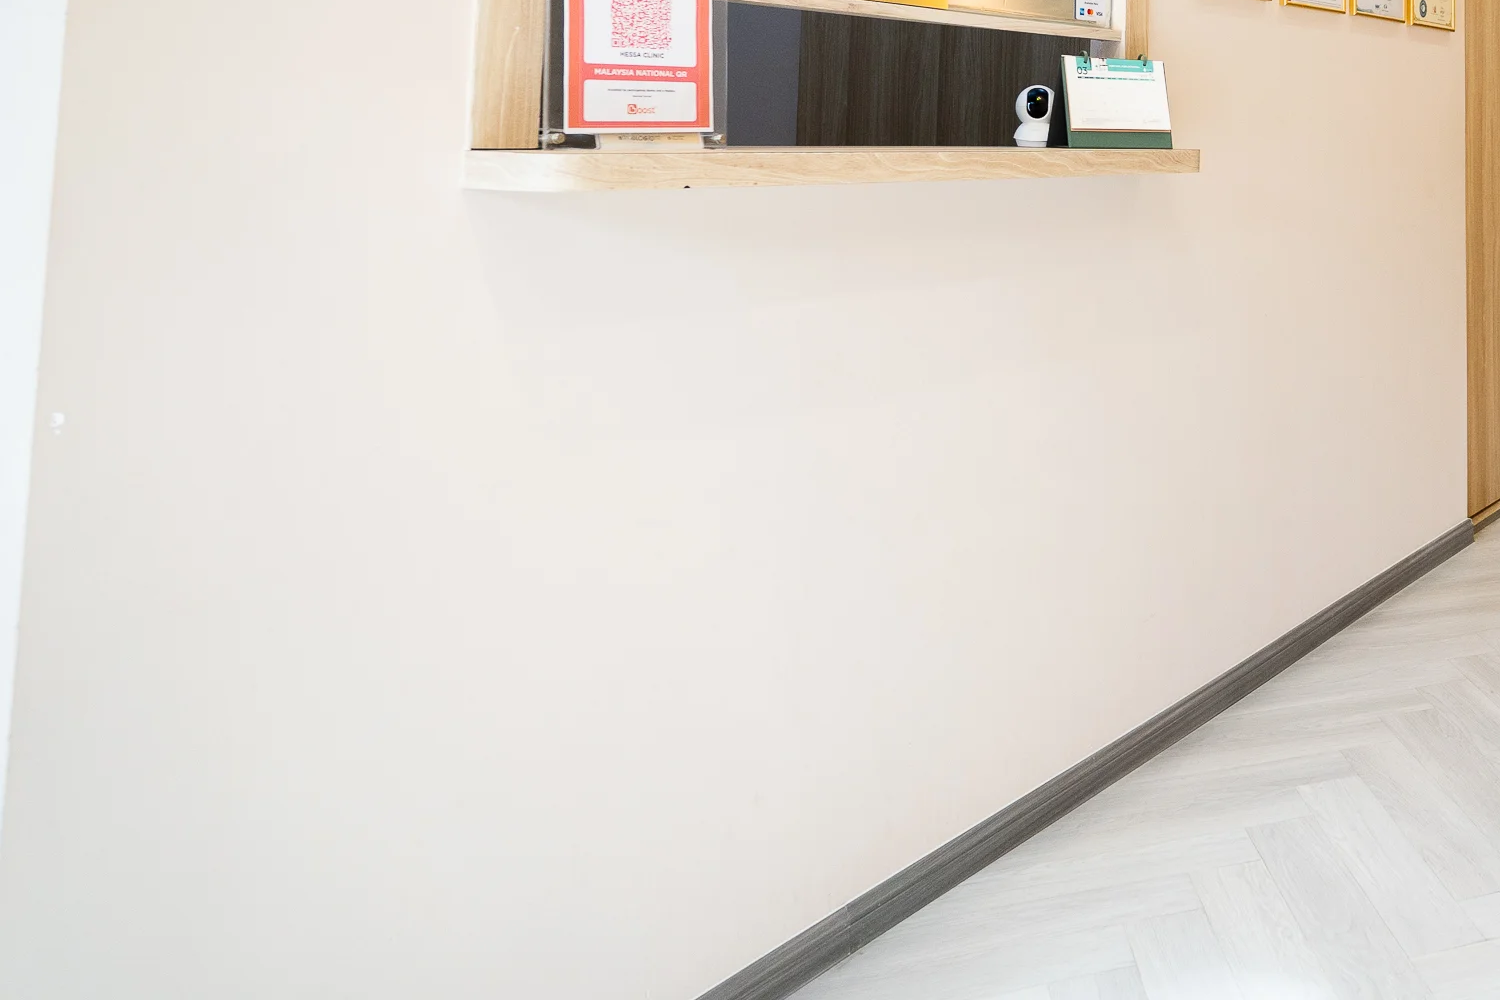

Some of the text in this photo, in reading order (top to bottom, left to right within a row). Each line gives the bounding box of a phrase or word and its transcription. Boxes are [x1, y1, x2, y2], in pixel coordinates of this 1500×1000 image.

[594, 68, 634, 76] MALAYSIA
[635, 69, 674, 78] NATIONAL
[1077, 66, 1088, 75] 03
